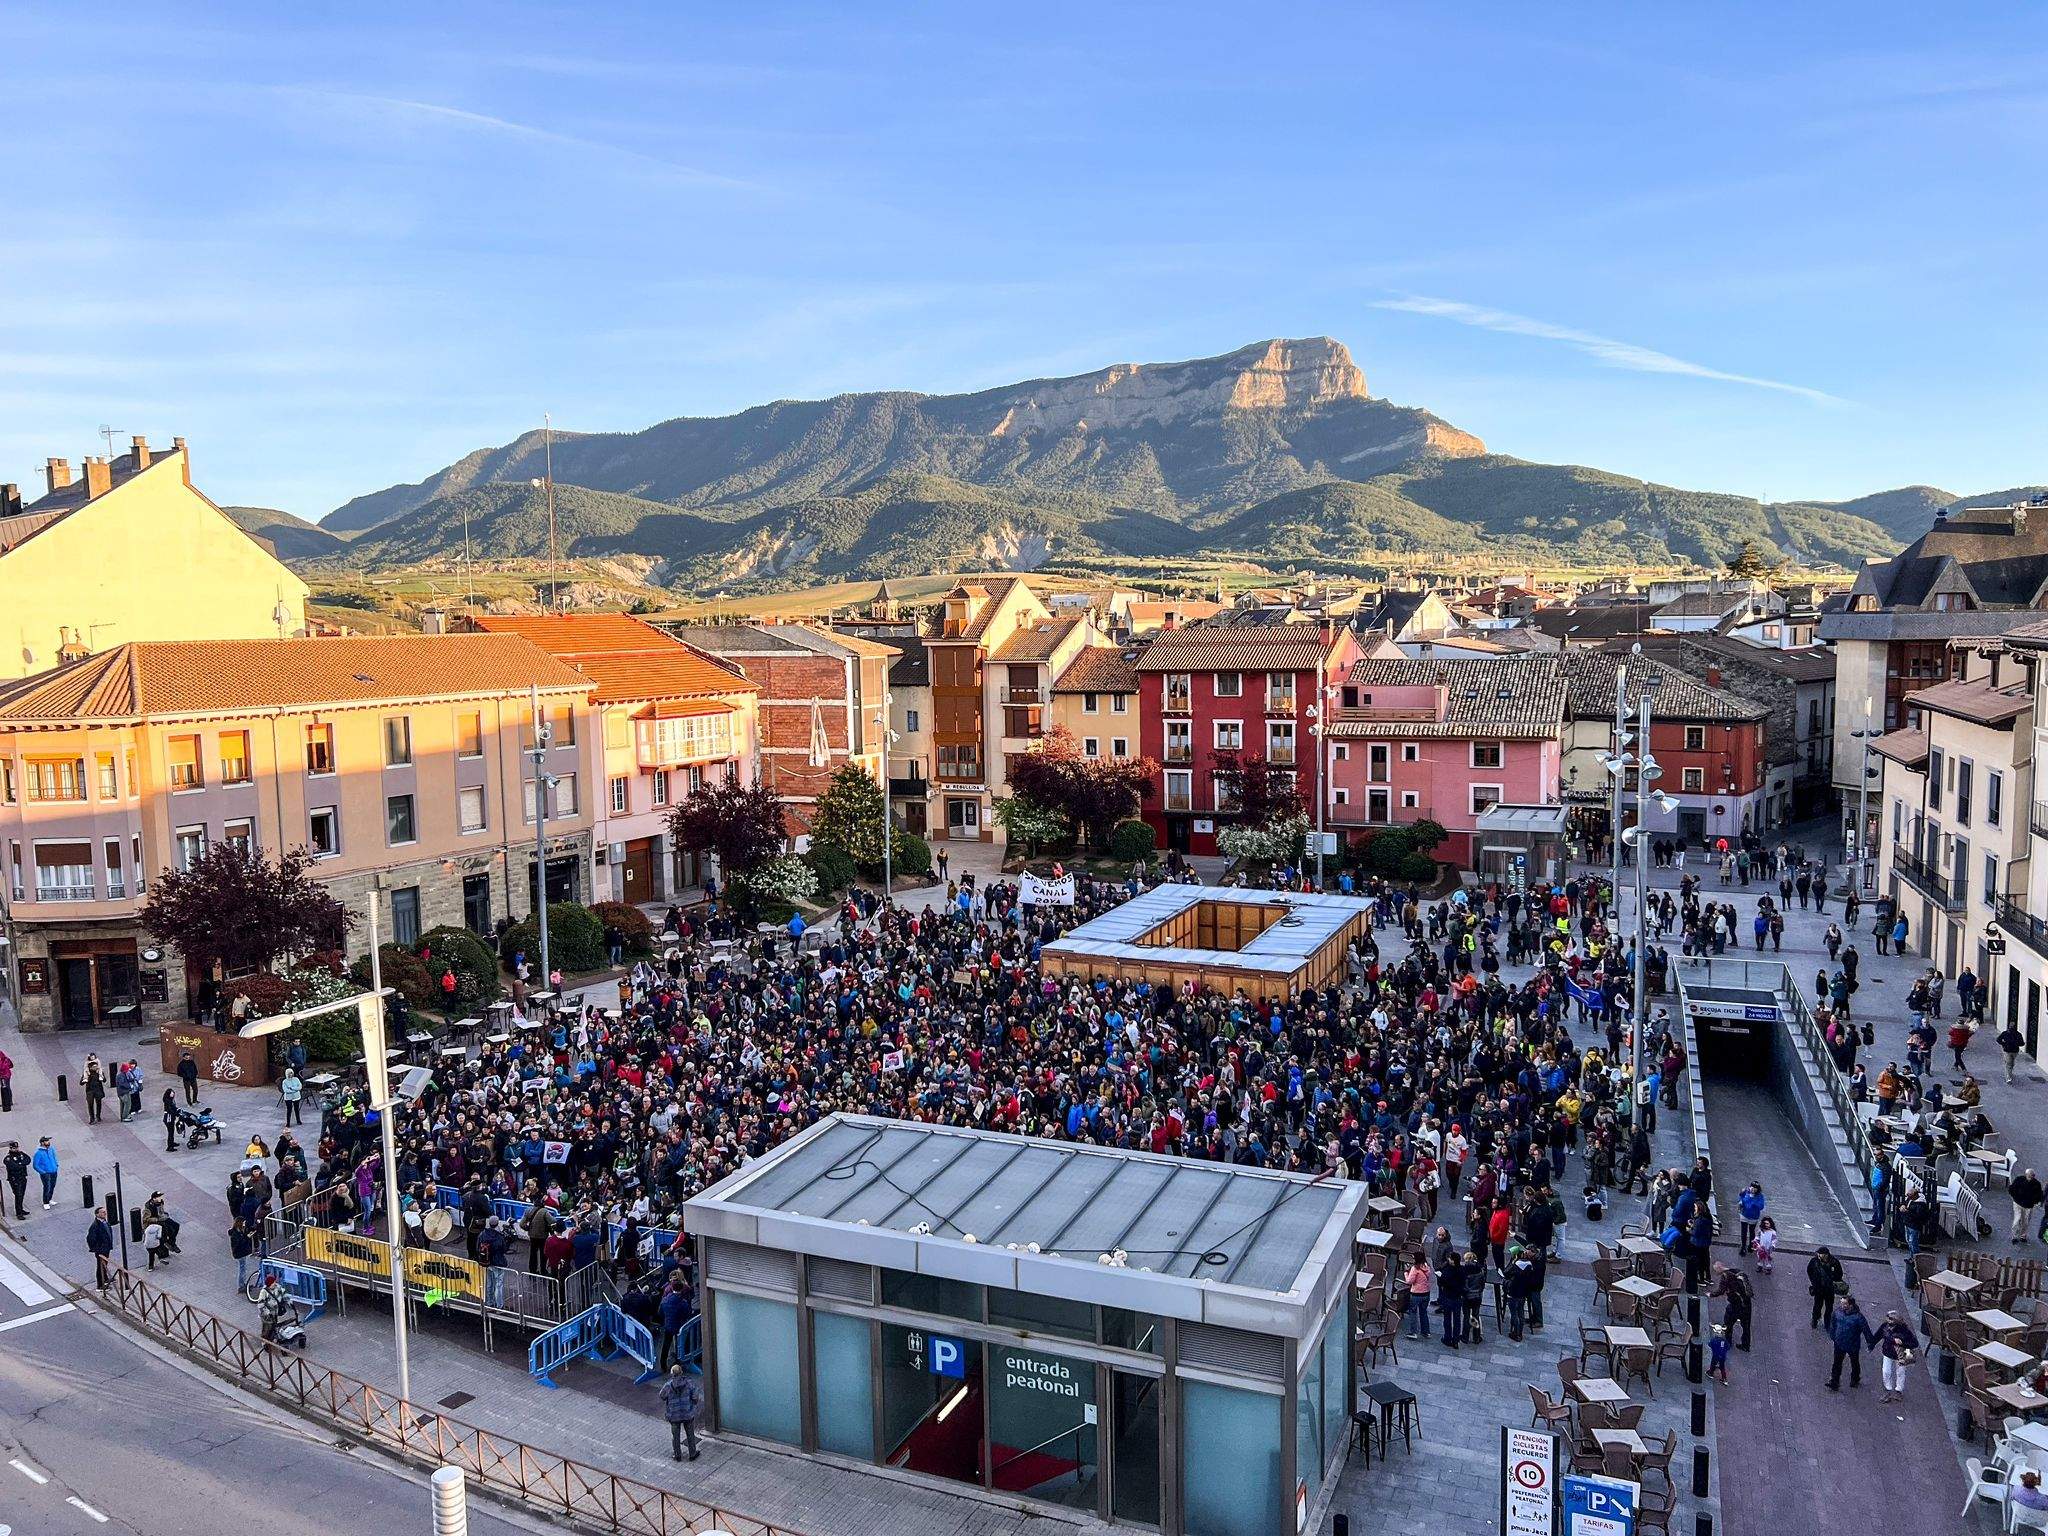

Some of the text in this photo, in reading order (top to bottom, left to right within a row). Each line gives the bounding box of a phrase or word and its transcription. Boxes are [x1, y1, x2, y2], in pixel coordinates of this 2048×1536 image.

[1032, 886, 1067, 896] CANAL
[935, 1340, 958, 1371] P
[1006, 1357, 1070, 1379] entrada
[1006, 1374, 1079, 1397] peatonal
[1513, 1433, 1549, 1445] ATENCIÓN
[1513, 1440, 1549, 1452] CICLISTAS
[1512, 1448, 1549, 1459] RECUERDE
[1523, 1469, 1537, 1480] 10
[1511, 1489, 1548, 1500] PREFERENCIA
[1515, 1496, 1544, 1505] PEATONAL
[1592, 1492, 1607, 1510] P
[1583, 1518, 1614, 1530] TARIFAS
